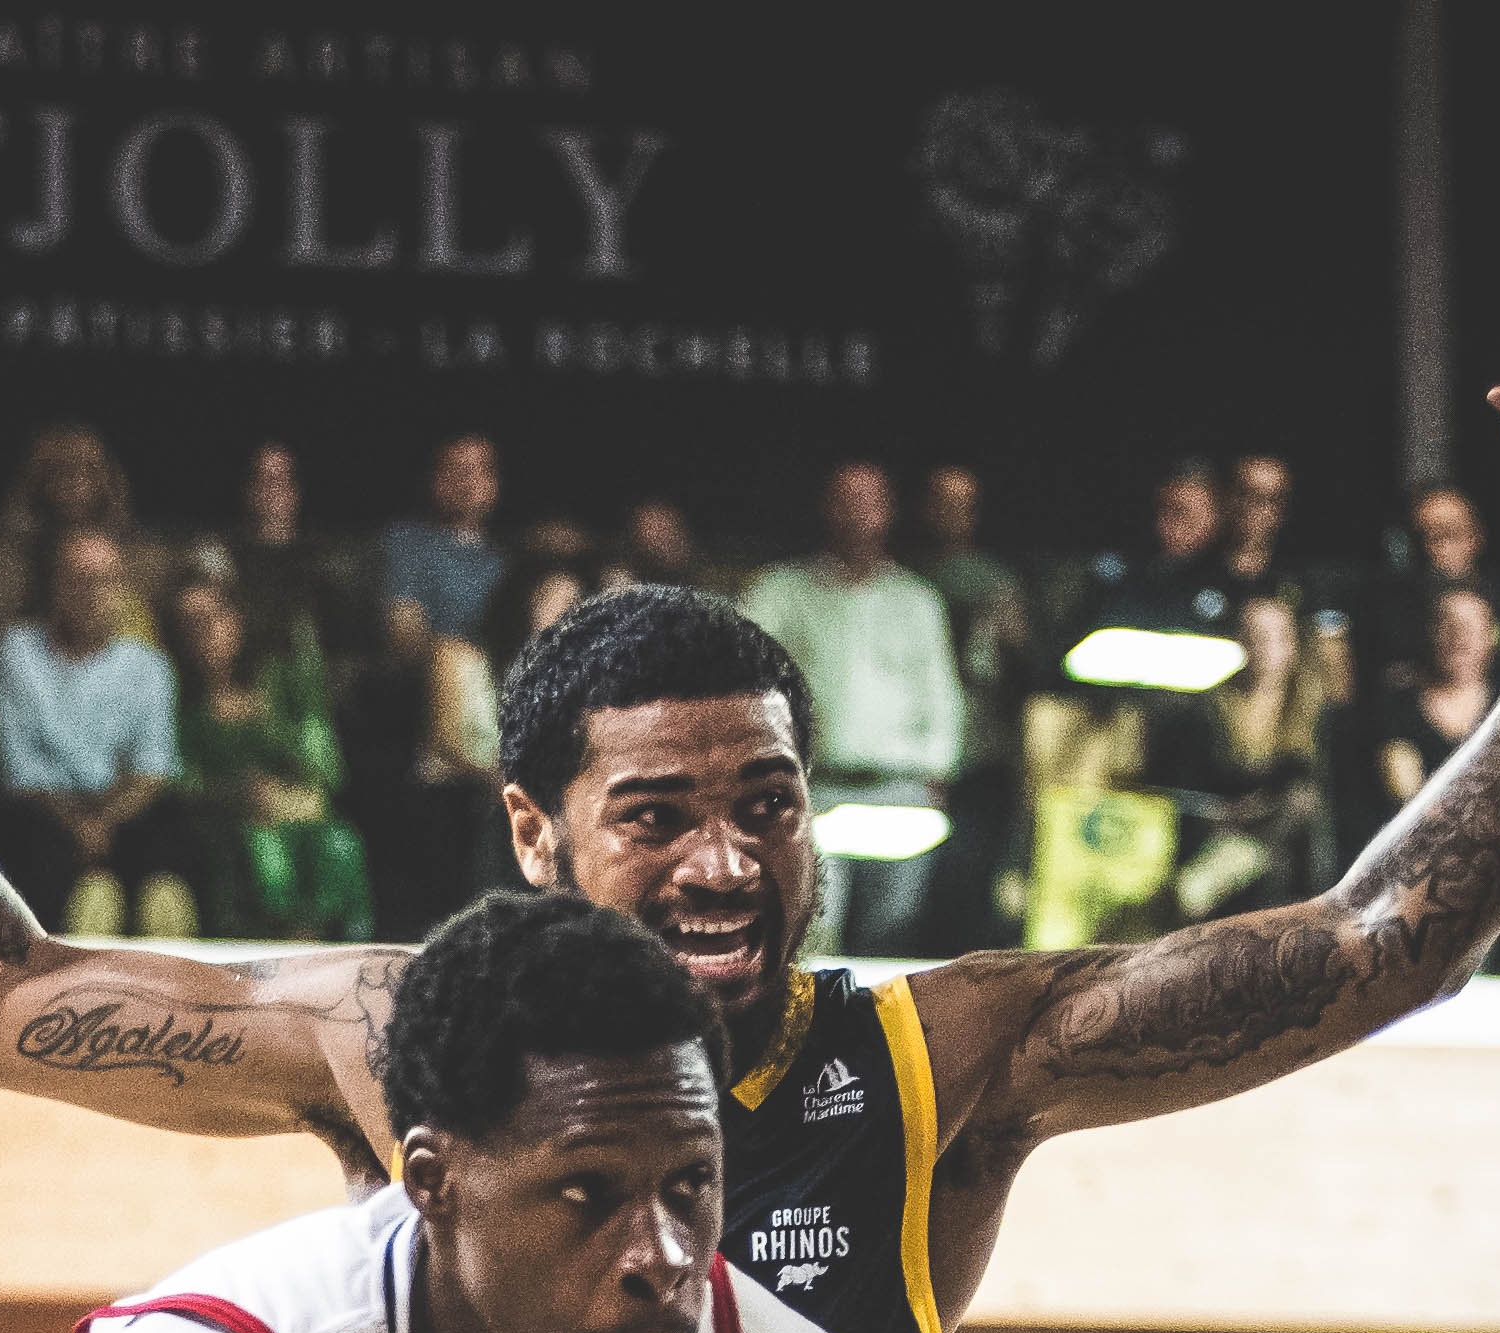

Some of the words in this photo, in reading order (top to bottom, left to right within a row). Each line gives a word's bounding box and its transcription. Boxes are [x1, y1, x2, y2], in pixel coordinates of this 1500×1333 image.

[804, 1088, 865, 1109] Charente
[802, 1101, 865, 1124] Maritime
[771, 1205, 832, 1228] GROUPE
[751, 1225, 850, 1263] RHINOS
